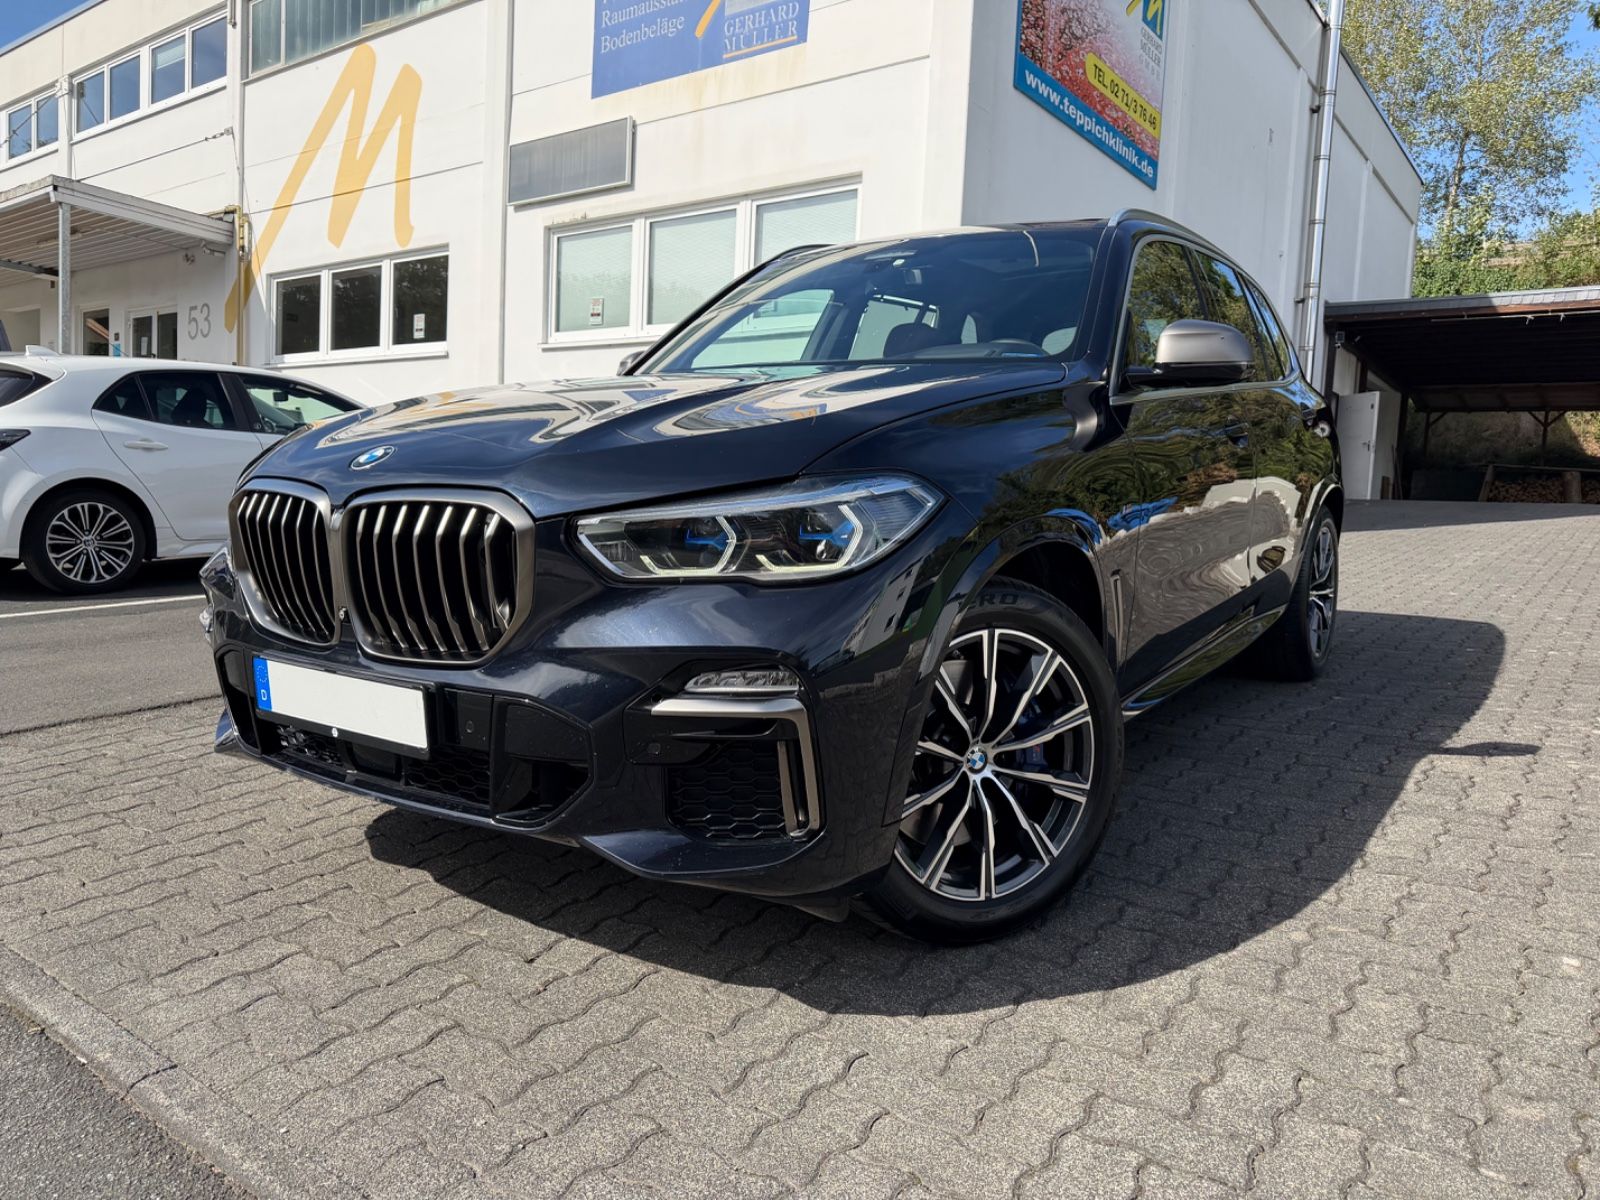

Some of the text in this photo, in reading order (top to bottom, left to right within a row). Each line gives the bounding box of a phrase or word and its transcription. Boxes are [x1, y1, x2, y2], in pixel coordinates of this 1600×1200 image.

[600, 16, 685, 54] Bodenbeläge
[724, 2, 799, 36] GERHARD
[1025, 70, 1154, 178] www.teppichklinik.de
[188, 303, 211, 340] 53
[260, 689, 268, 701] D
